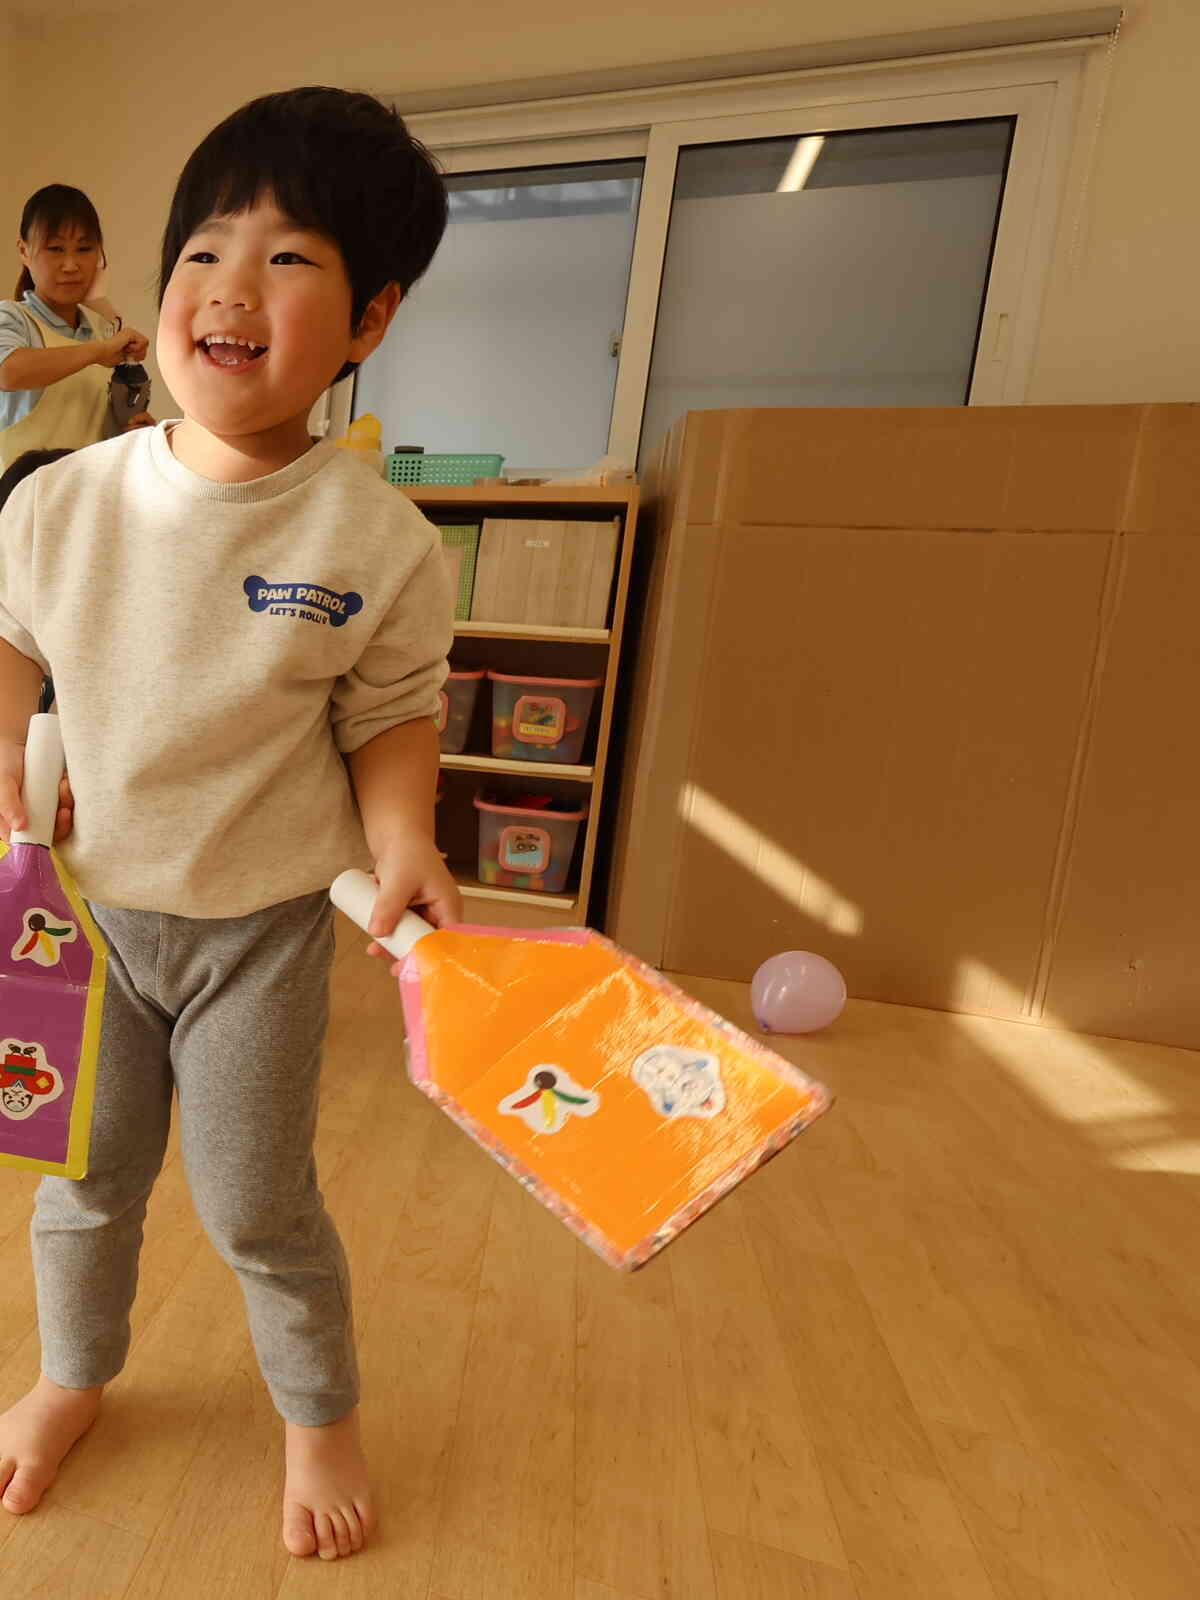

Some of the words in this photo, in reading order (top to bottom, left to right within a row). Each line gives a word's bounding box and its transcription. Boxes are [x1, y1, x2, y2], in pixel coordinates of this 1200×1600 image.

[257, 588, 292, 600] PAW
[296, 587, 347, 614] PATROL
[270, 607, 296, 616] LET'S
